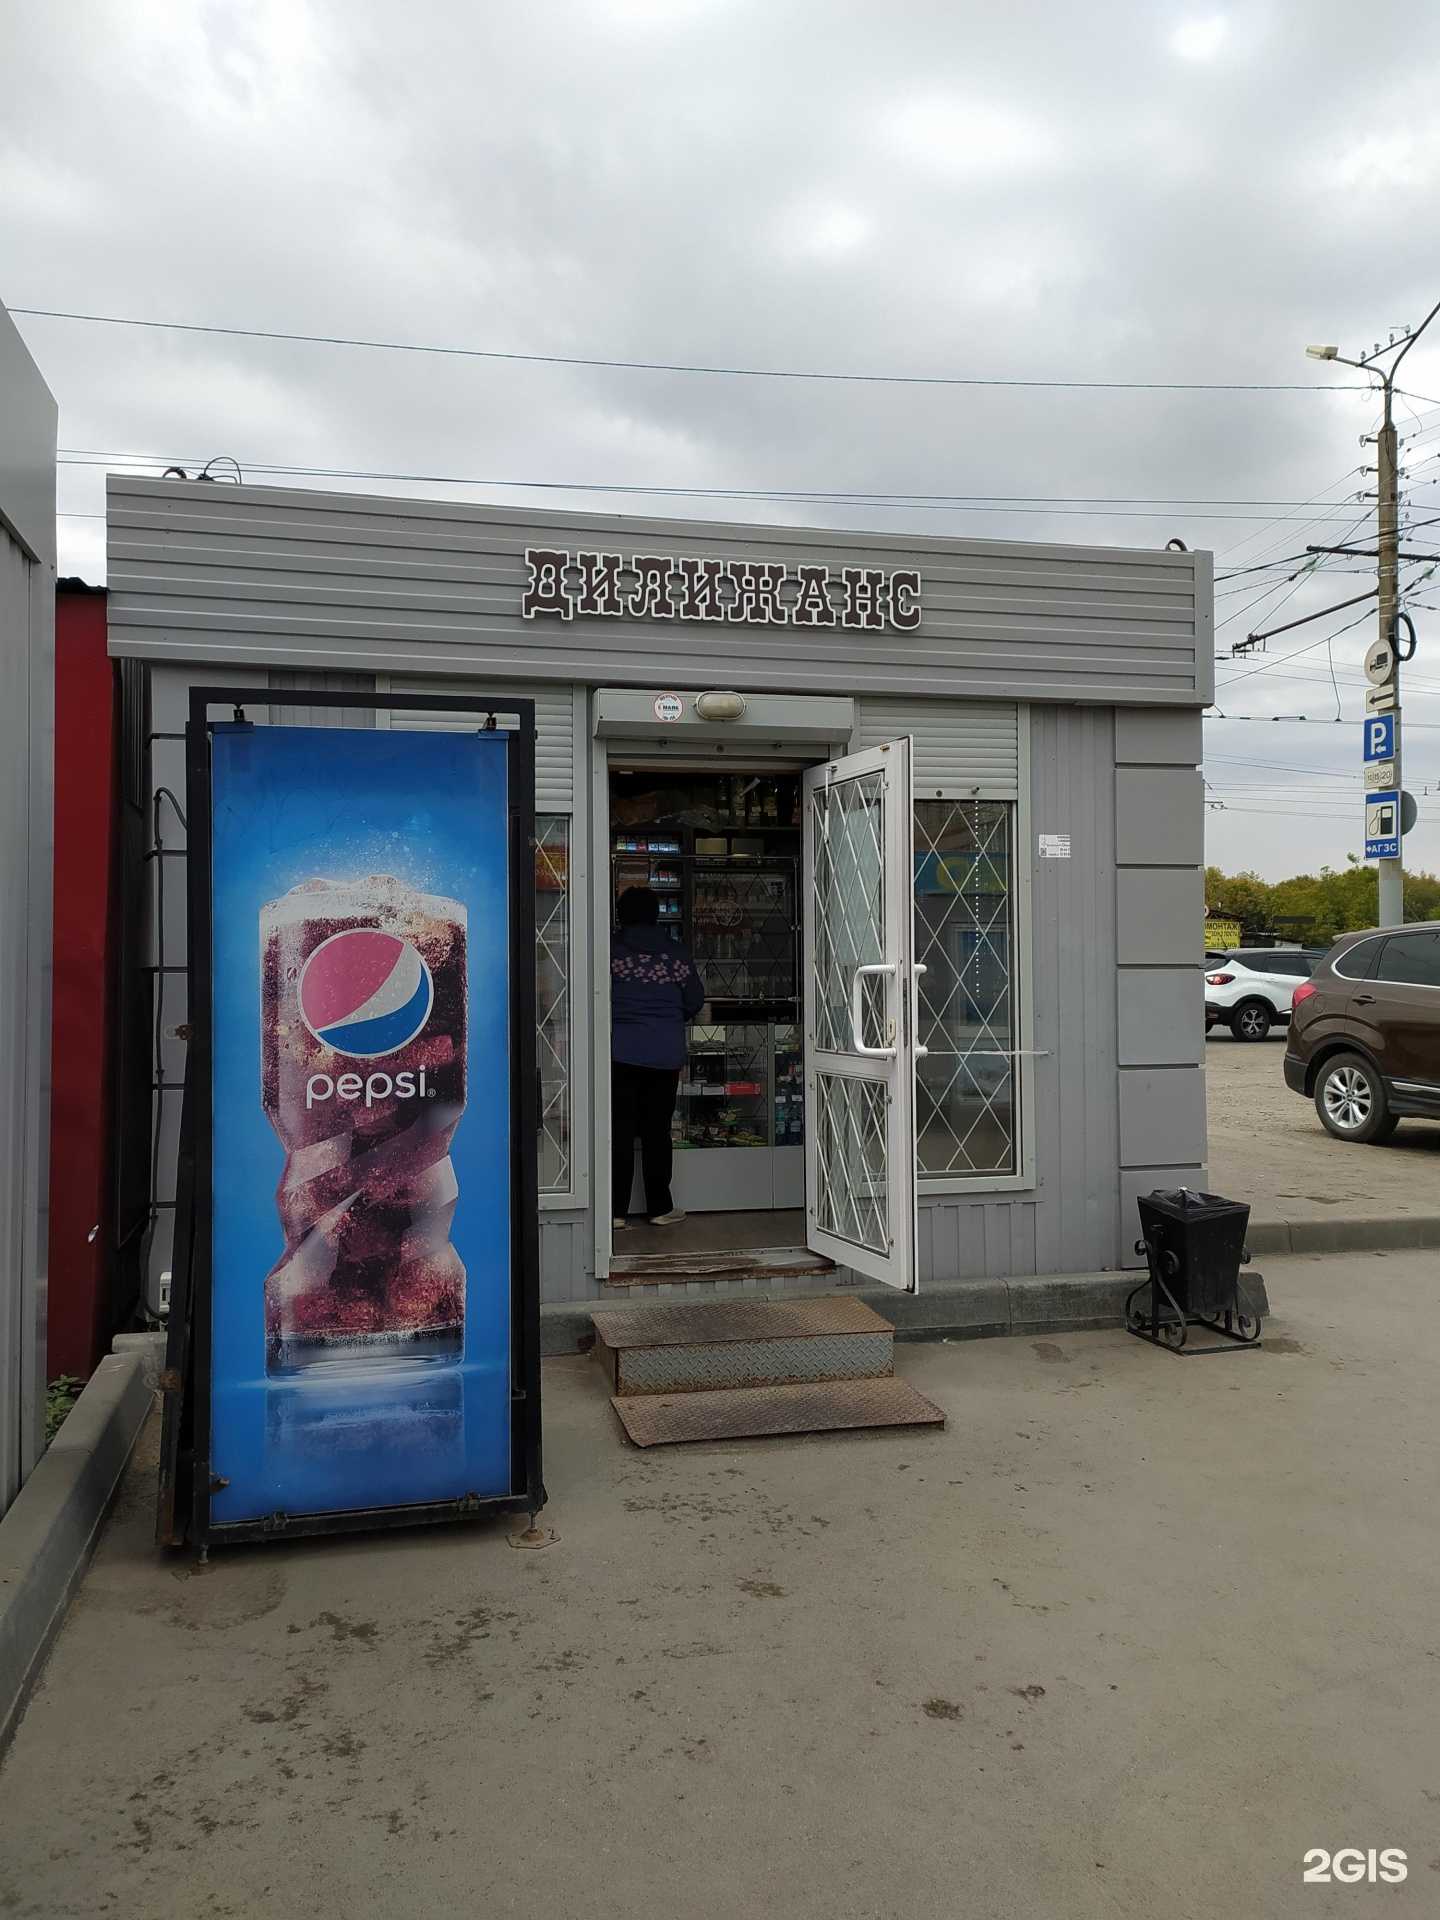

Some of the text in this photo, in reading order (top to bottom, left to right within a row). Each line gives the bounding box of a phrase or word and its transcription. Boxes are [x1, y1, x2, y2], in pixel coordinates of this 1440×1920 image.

[522, 547, 922, 631] ДИЛИЖАНС
[1371, 843, 1397, 854] АГЗС
[1205, 922, 1238, 930] МОНТАЖ
[306, 1064, 426, 1109] pepsi
